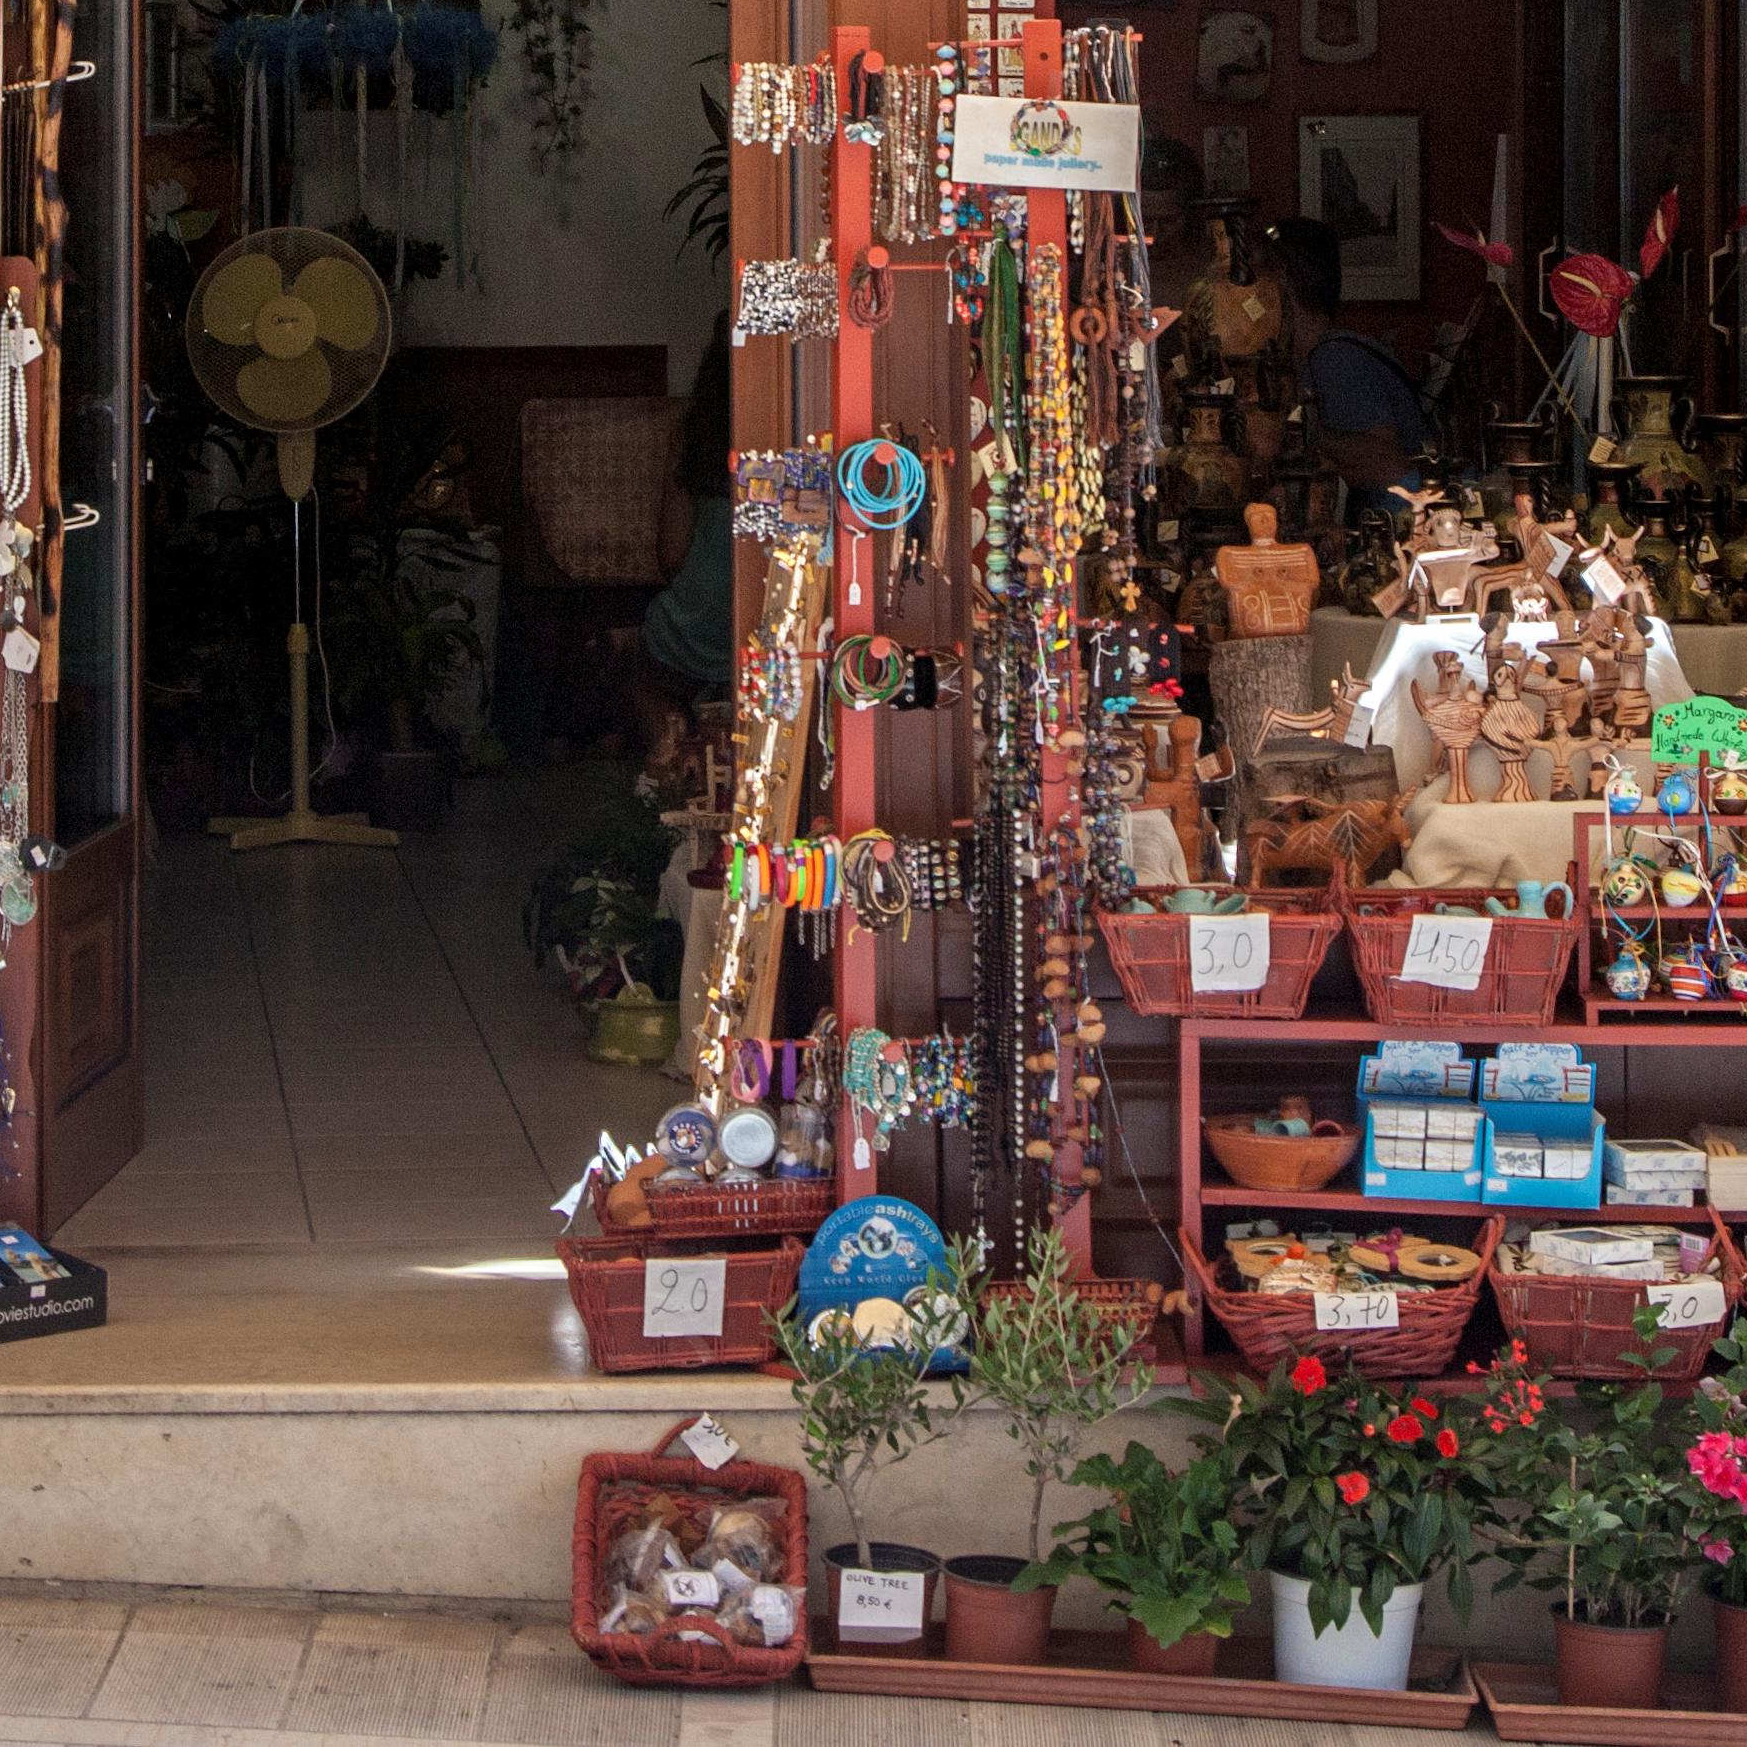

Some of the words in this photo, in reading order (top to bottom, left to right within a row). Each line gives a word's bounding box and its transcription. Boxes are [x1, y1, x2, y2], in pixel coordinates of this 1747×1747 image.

[984, 153, 1018, 165] paper
[1682, 701, 1735, 725] Margaro
[1197, 929, 1253, 976] 3,0
[1410, 923, 1480, 974] 4,50
[1325, 1295, 1390, 1326] 3,70
[847, 1574, 875, 1585] OLIVE
[880, 1577, 909, 1590] TREE
[857, 1595, 880, 1608] 8,50
[884, 1599, 894, 1609] €
